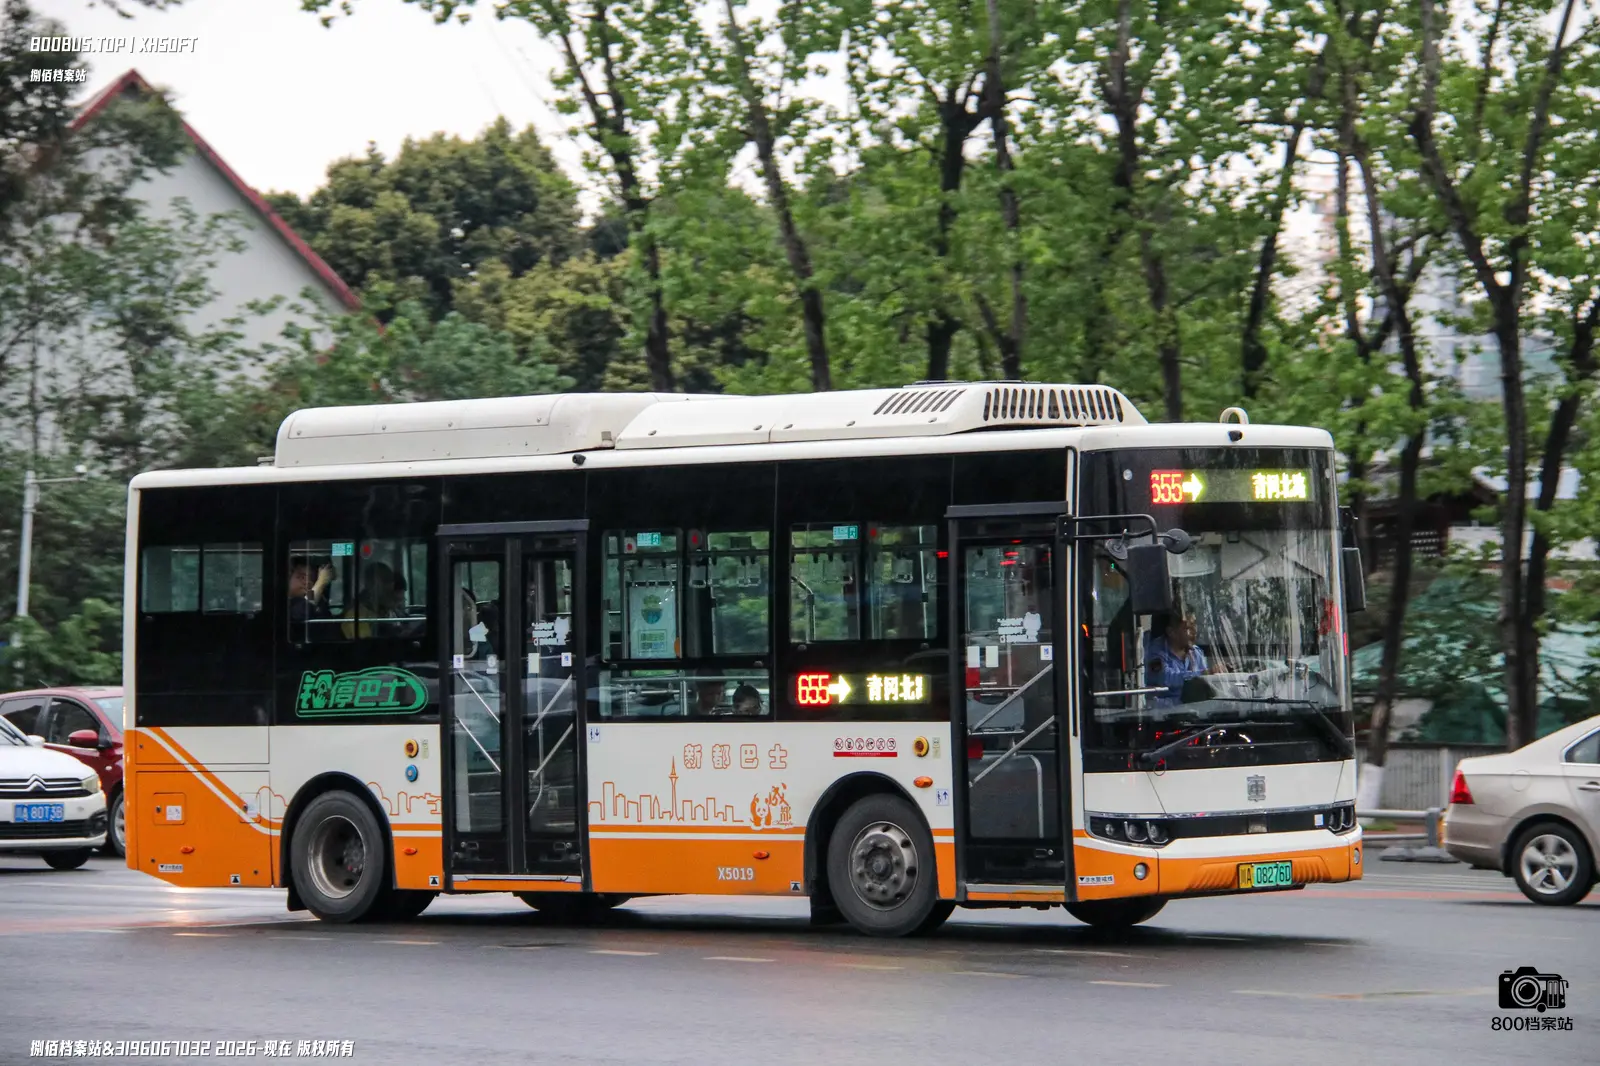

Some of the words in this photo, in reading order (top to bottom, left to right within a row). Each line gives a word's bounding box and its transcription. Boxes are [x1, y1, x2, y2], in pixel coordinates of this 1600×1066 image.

[1151, 472, 1183, 503] 655
[798, 673, 831, 704] 655
[683, 743, 788, 769] 新都巴士
[717, 867, 755, 881] X5019
